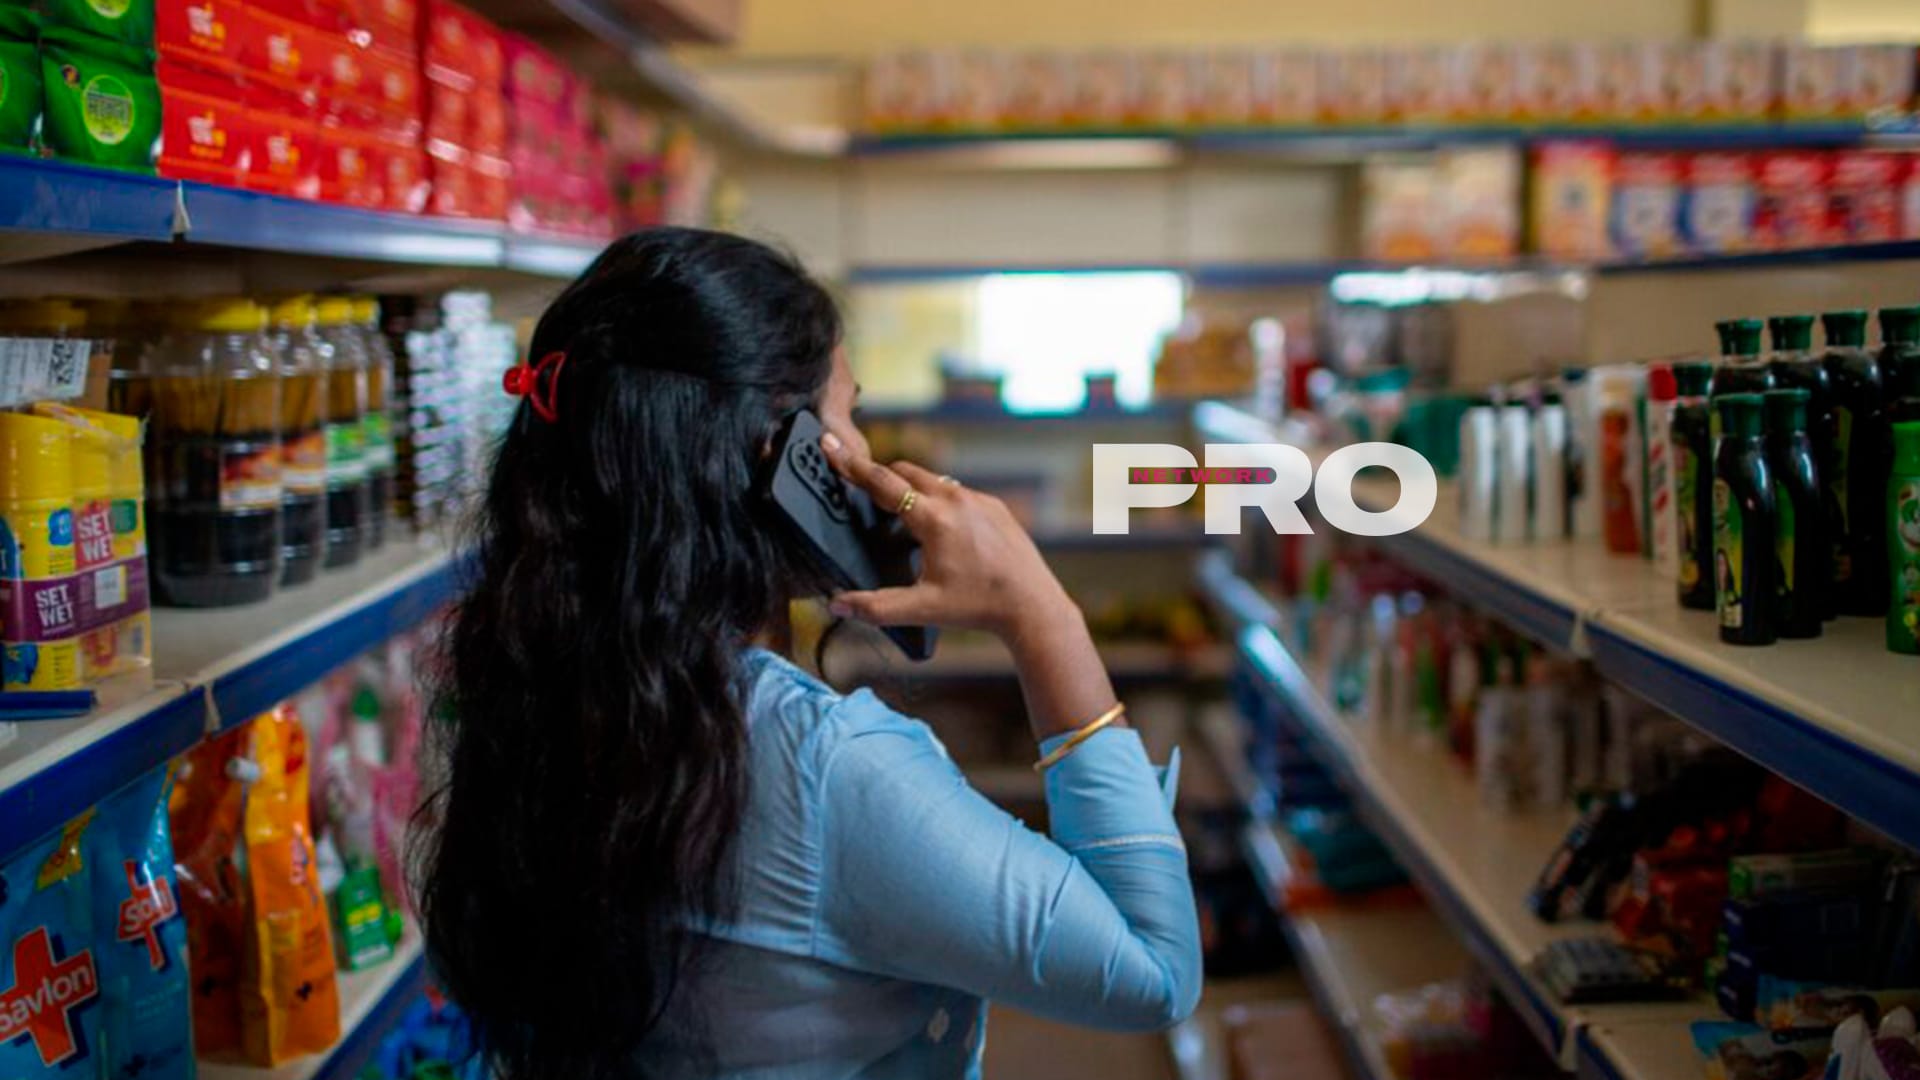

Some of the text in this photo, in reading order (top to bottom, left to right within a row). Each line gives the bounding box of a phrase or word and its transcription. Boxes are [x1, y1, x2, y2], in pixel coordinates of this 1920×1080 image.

[77, 509, 112, 539] SET
[80, 533, 113, 562] WE
[35, 583, 70, 609] SET
[37, 602, 74, 627] WET
[0, 965, 92, 1032] Savlon
